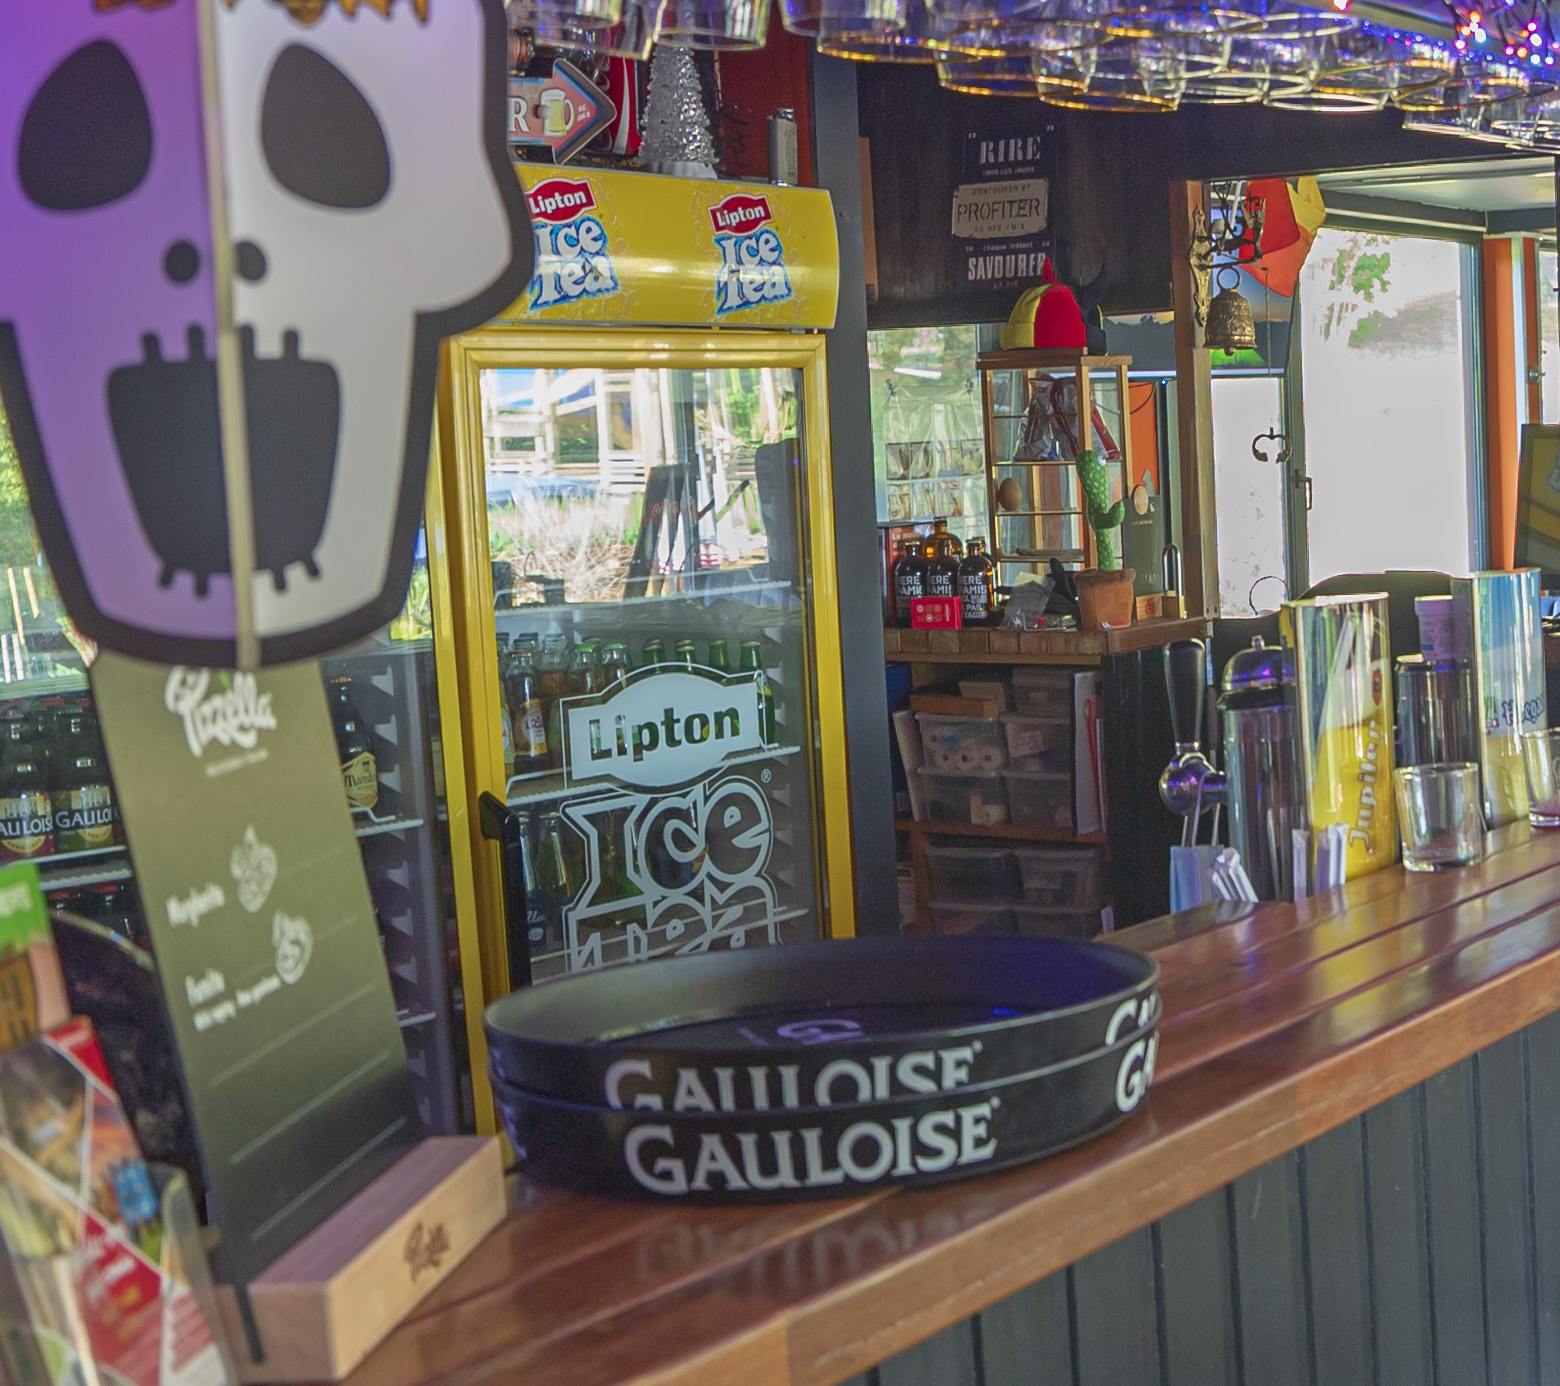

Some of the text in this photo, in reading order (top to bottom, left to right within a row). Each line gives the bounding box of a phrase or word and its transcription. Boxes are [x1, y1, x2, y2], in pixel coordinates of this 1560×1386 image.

[980, 136, 1041, 164] RIRE
[529, 190, 587, 214] Lipton
[716, 203, 765, 227] Lipton
[957, 198, 1040, 223] PROFITER
[535, 219, 604, 259] Ice
[719, 232, 781, 270] Ice
[532, 255, 617, 309] Tea
[717, 266, 791, 312] Tea
[589, 704, 741, 763] Lipton
[1348, 720, 1380, 853] Jupiler
[564, 781, 769, 912] Ice
[606, 1045, 976, 1111] GAULOISE
[624, 1102, 997, 1195] GAULOISE
